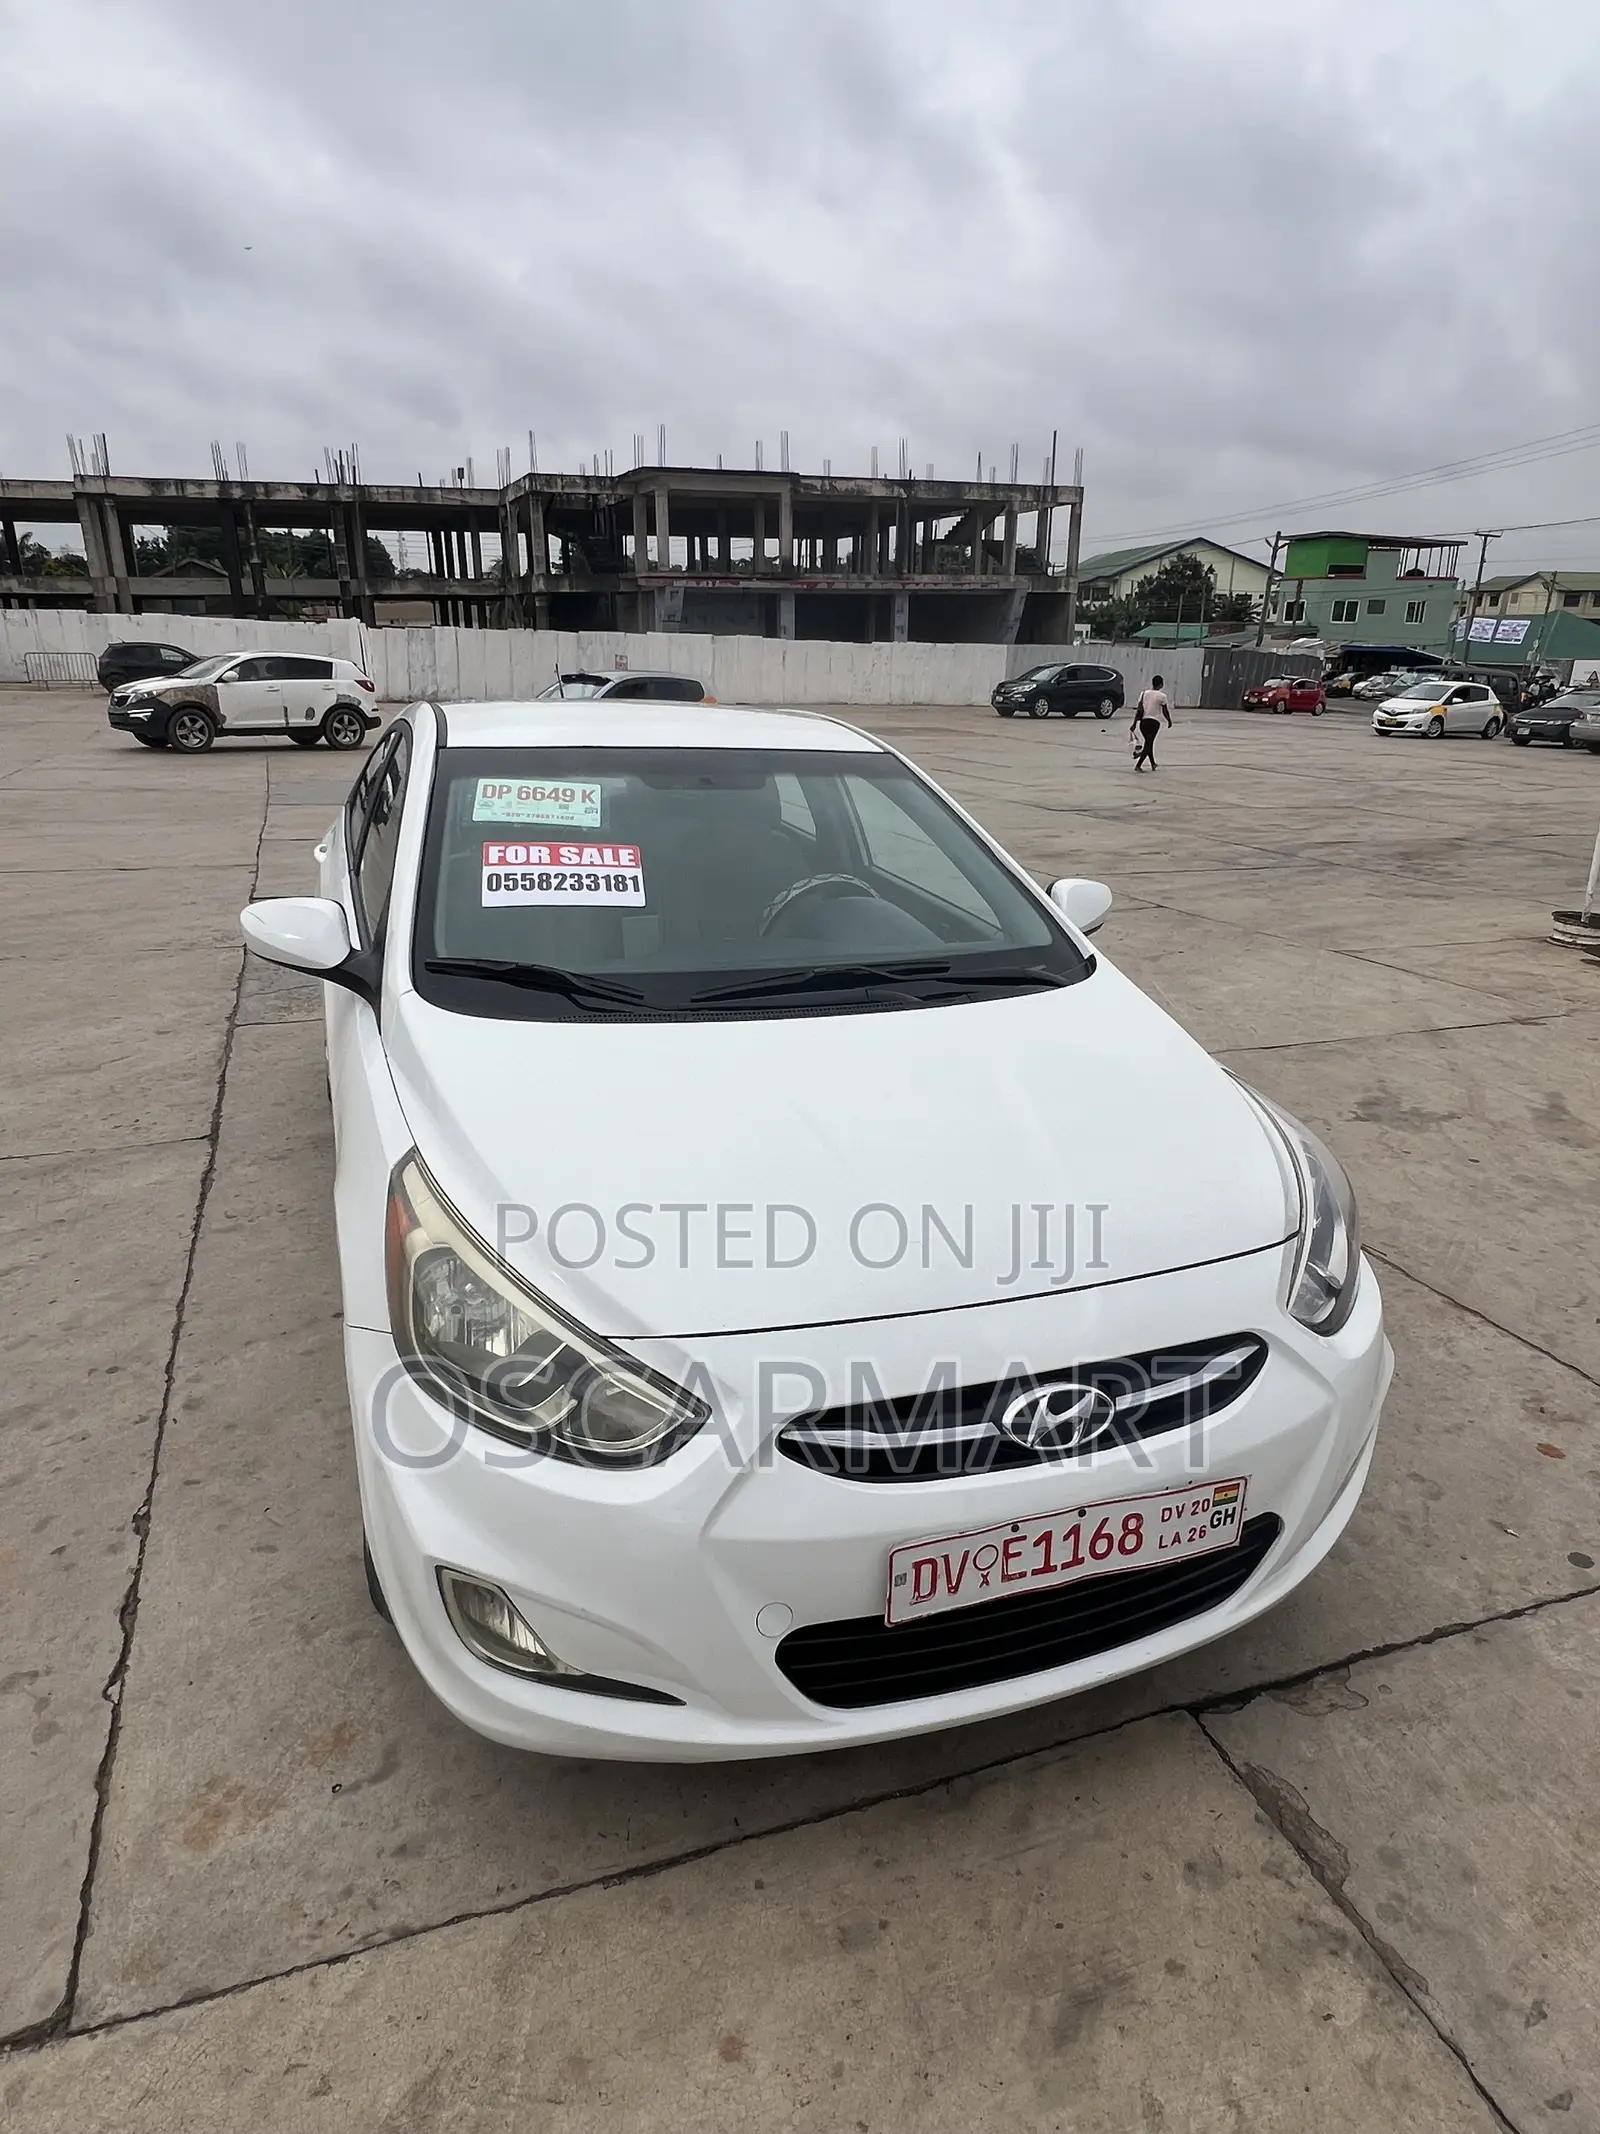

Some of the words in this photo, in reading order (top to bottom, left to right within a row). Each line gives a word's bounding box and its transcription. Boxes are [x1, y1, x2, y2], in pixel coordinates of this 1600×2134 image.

[482, 784, 512, 800] DP
[517, 785, 576, 803] 6649
[581, 789, 597, 805] K
[488, 845, 550, 865] FOR
[558, 847, 636, 867] SALE
[486, 872, 640, 893] 0558233181
[1161, 1503, 1186, 1522] DV
[1190, 1498, 1211, 1516] 20
[1210, 1506, 1237, 1529] GH
[1158, 1531, 1182, 1549] LA
[1187, 1525, 1207, 1542] 26
[910, 1550, 970, 1606] DV
[1001, 1512, 1144, 1583] E1168
